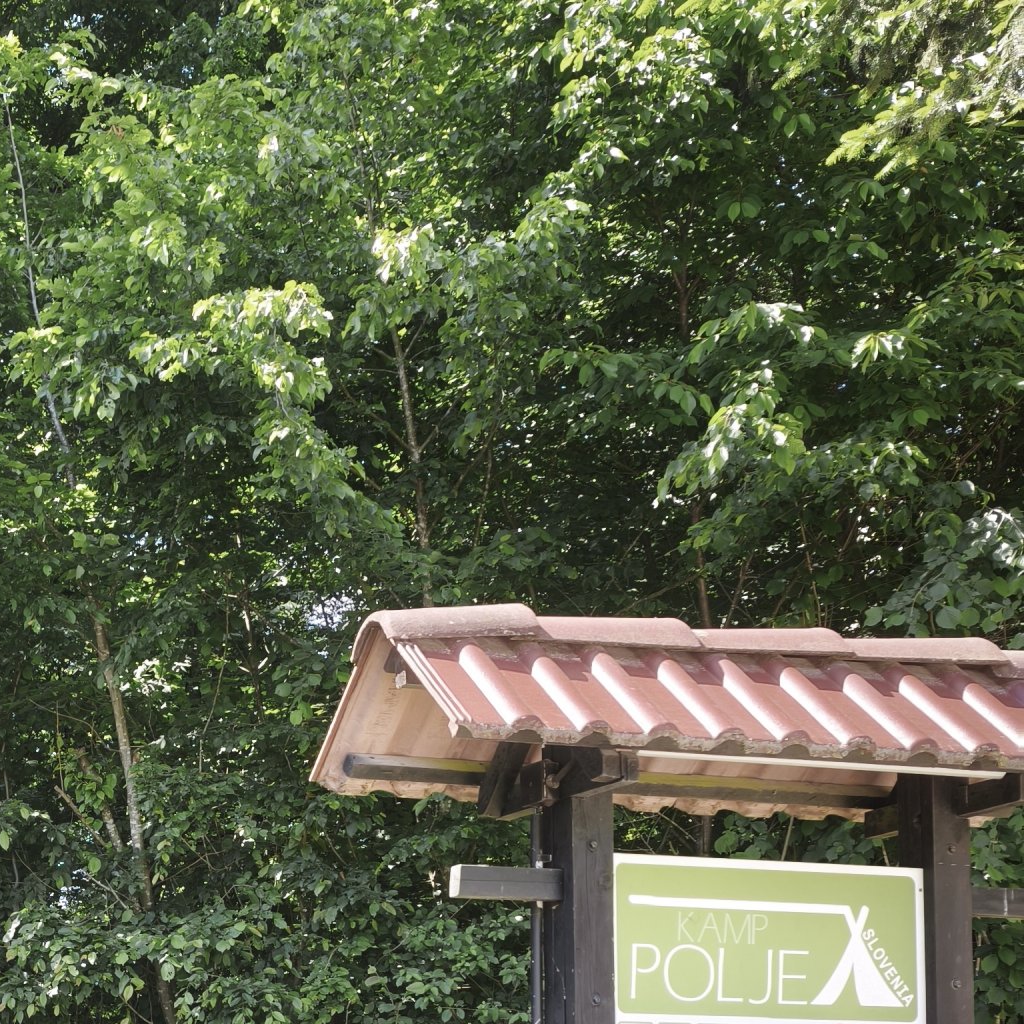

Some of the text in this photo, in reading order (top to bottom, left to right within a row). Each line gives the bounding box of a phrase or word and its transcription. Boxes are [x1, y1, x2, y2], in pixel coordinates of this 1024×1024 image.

[678, 911, 768, 945] KAMP
[630, 943, 810, 1005] POLJE
[862, 928, 915, 1008] SLOVENIA
